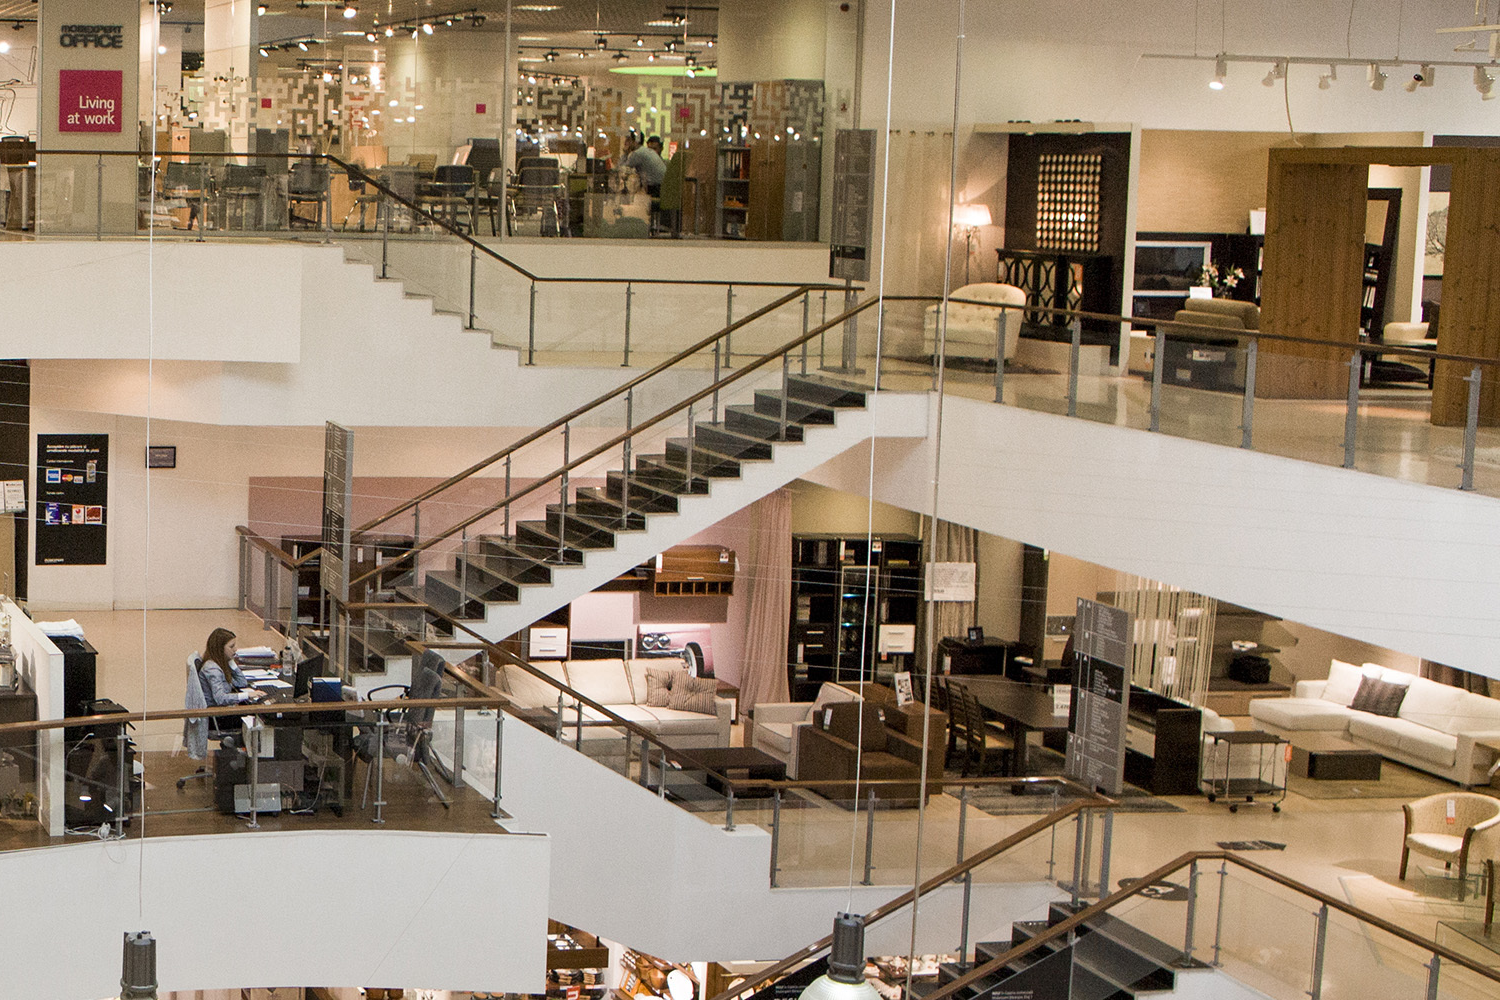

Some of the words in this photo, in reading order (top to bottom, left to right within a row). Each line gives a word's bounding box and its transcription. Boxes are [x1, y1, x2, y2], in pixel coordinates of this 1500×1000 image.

[60, 33, 123, 48] OFFICE
[79, 96, 115, 112] Living
[67, 112, 81, 124] at
[84, 111, 115, 125] work
